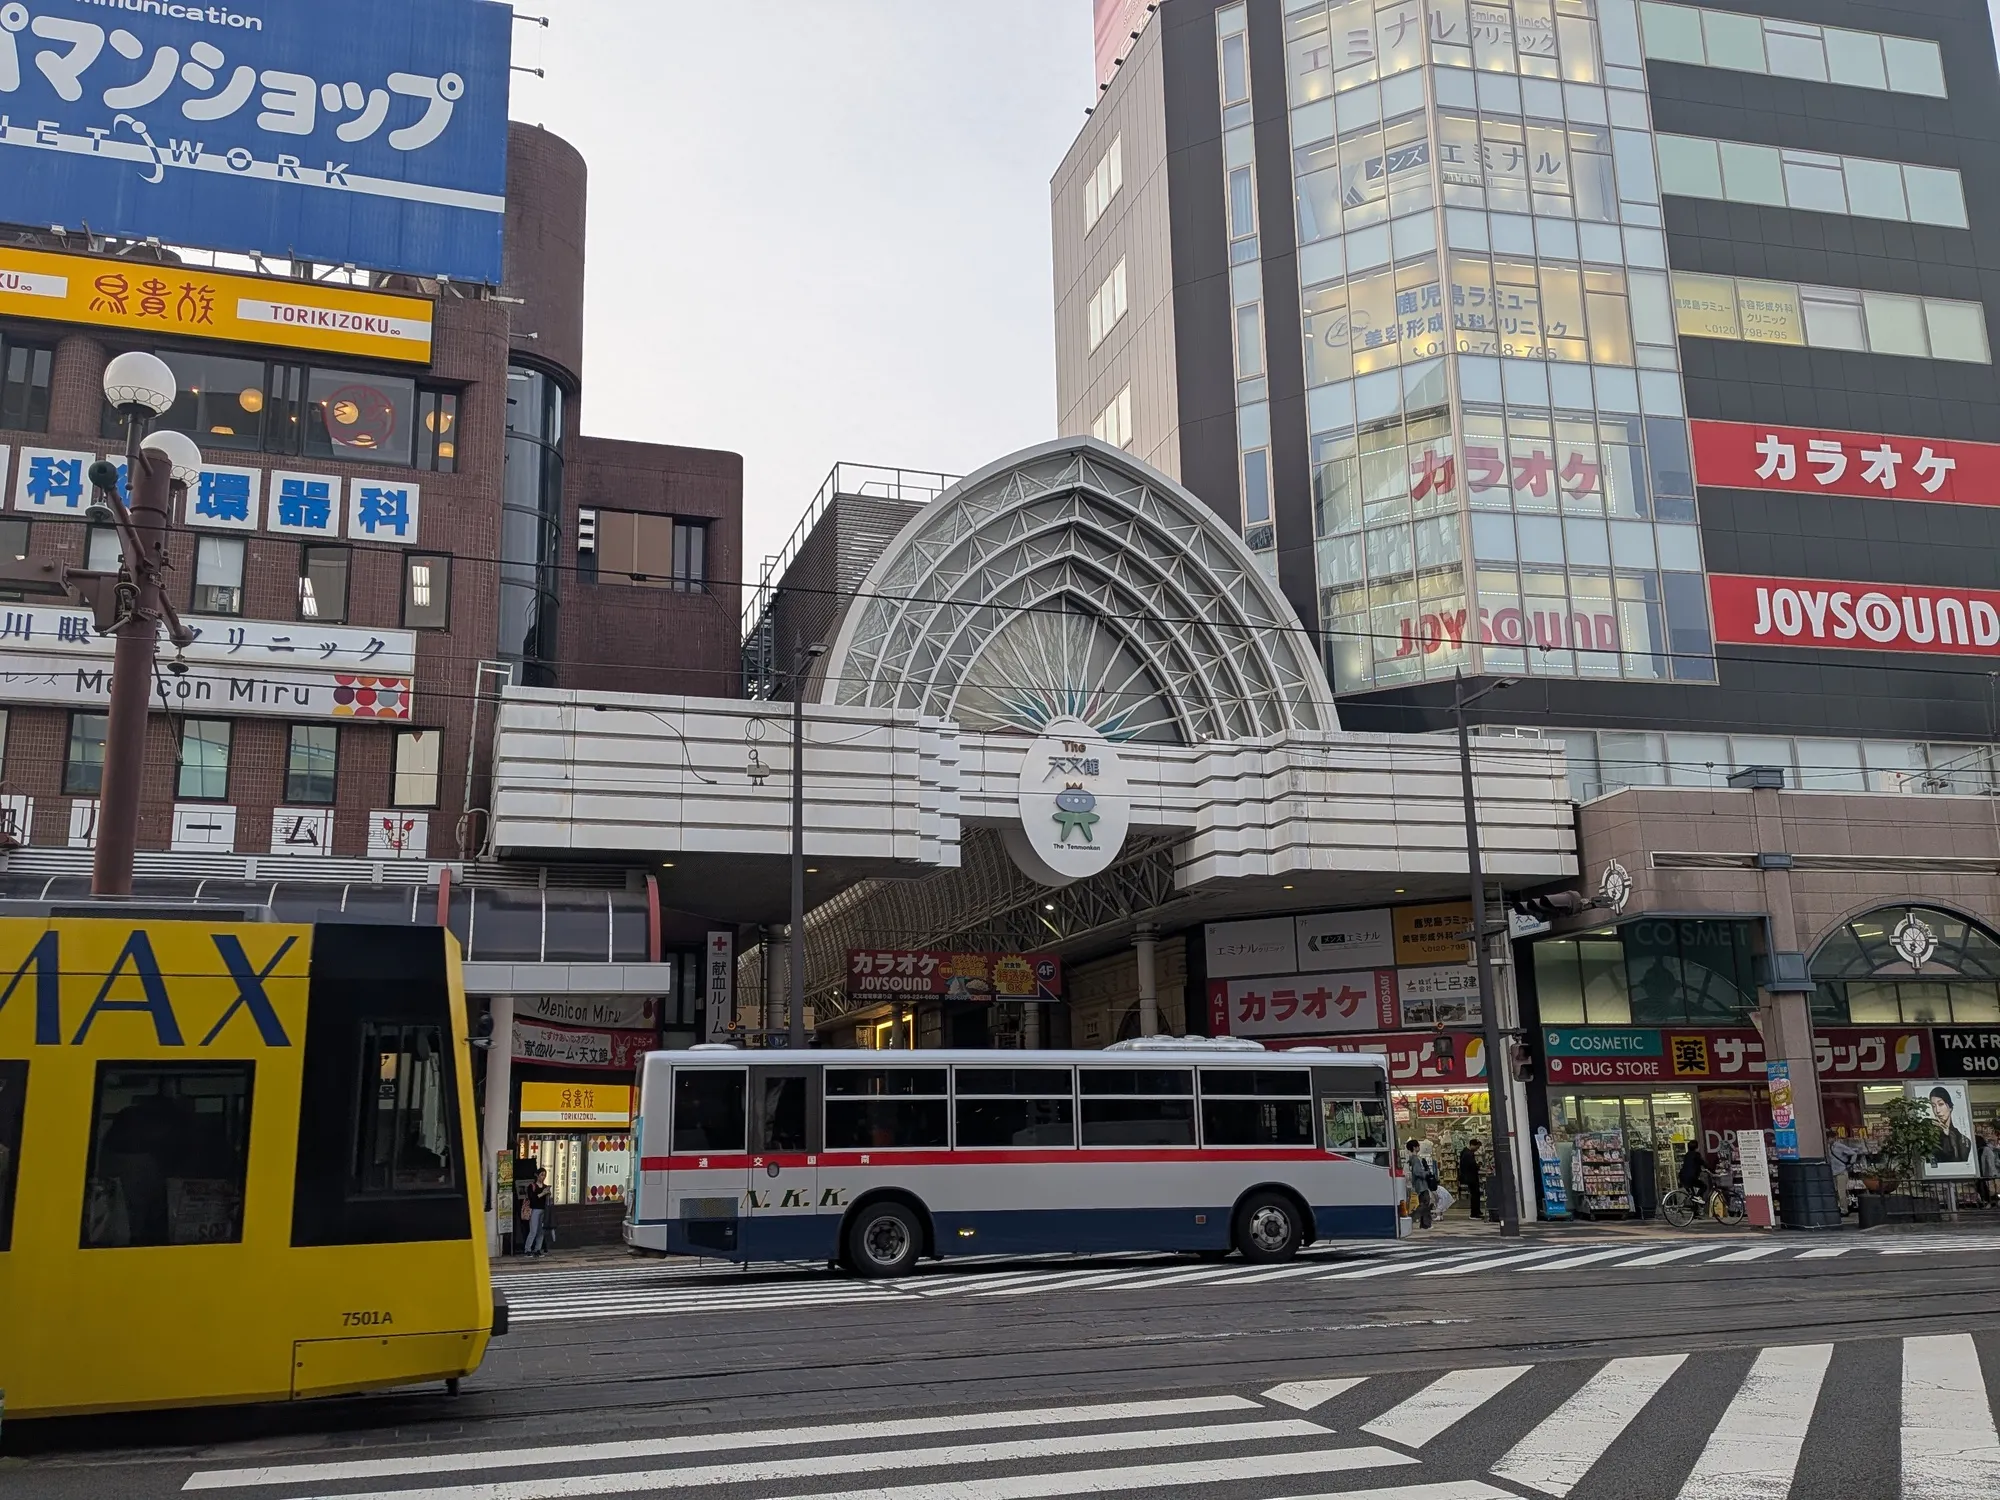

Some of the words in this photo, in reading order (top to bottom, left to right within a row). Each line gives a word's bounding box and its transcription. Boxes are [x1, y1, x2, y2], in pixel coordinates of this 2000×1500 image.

[1300, 9, 1457, 75] エミナル
[1372, 146, 1424, 178] メンズ
[1441, 143, 1562, 176] エミナル
[89, 273, 214, 326] 鳥貴族
[1410, 446, 1600, 500] カラオケ
[1755, 434, 1957, 494] カラオケ
[26, 456, 410, 537] 科環器科
[1754, 587, 2000, 647] JOYSOUND
[1396, 605, 1620, 657] JOYSOUND
[229, 674, 310, 706] Miru
[1062, 740, 1087, 754] The
[1042, 756, 1100, 783] 天文館
[1067, 843, 1101, 851] Tenmonkan
[1216, 943, 1259, 956] エミナル
[1322, 935, 1343, 943] メンズ
[1346, 931, 1381, 942] エミナル
[852, 952, 940, 976] カラオケ
[1038, 965, 1054, 976] 4F
[859, 976, 932, 991] JOYSOUND
[1006, 982, 1023, 992] OK
[537, 996, 588, 1021] Menicon
[593, 1004, 621, 1023] Miru
[711, 960, 727, 1035] 献血ルーム
[1238, 985, 1368, 1023] カラオケ
[1380, 975, 1393, 1025] JOYSOUND
[1569, 1036, 1644, 1050] COSMETIC
[1940, 1034, 1977, 1049] TAX
[1572, 1062, 1612, 1076] DRUG
[1616, 1061, 1660, 1076] STORE
[1674, 1039, 1707, 1073] 薬
[560, 1088, 594, 1109] 鳥貴族
[1419, 1097, 1445, 1113] 本日
[596, 1162, 619, 1175] Miru
[341, 1311, 394, 1327] 7501A
